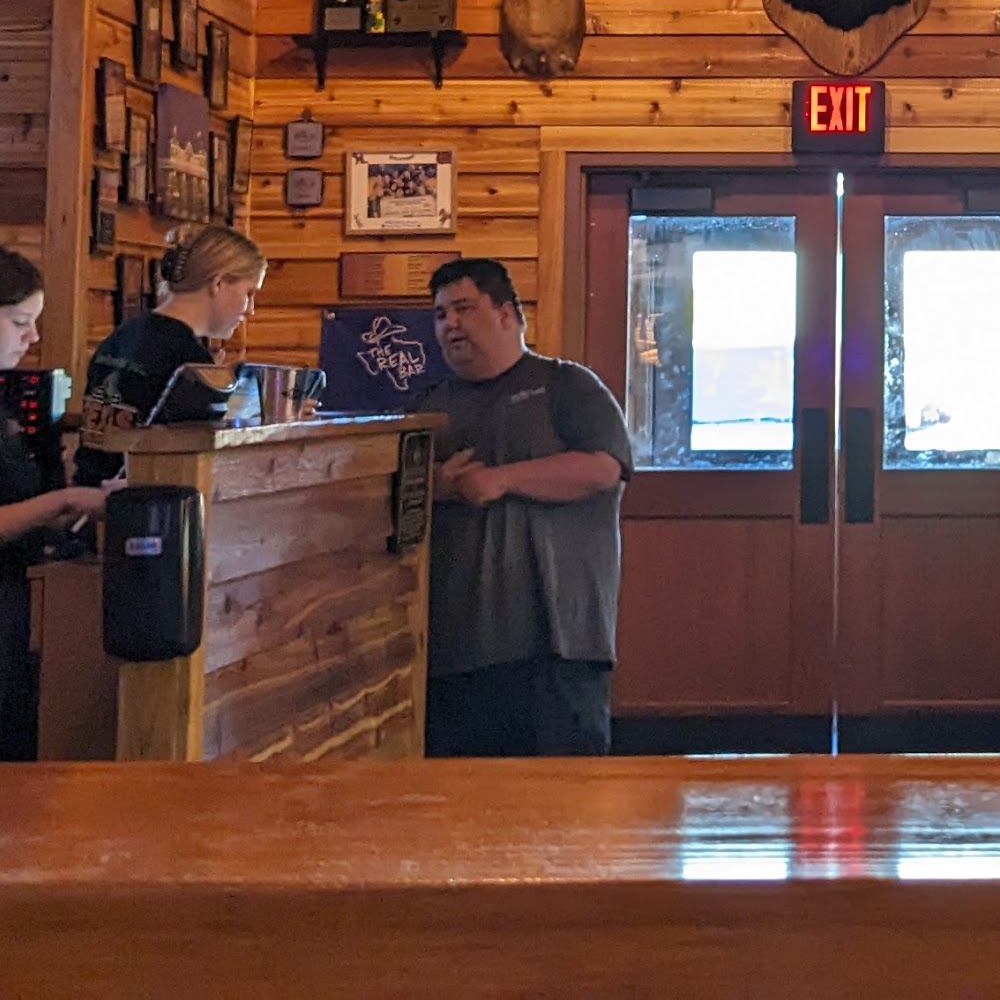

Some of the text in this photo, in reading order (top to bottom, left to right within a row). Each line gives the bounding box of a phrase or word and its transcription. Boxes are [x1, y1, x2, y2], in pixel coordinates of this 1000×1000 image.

[810, 86, 871, 132] EXIT
[369, 343, 392, 358] THE
[376, 350, 420, 370] REAL
[399, 363, 425, 380] BAR
